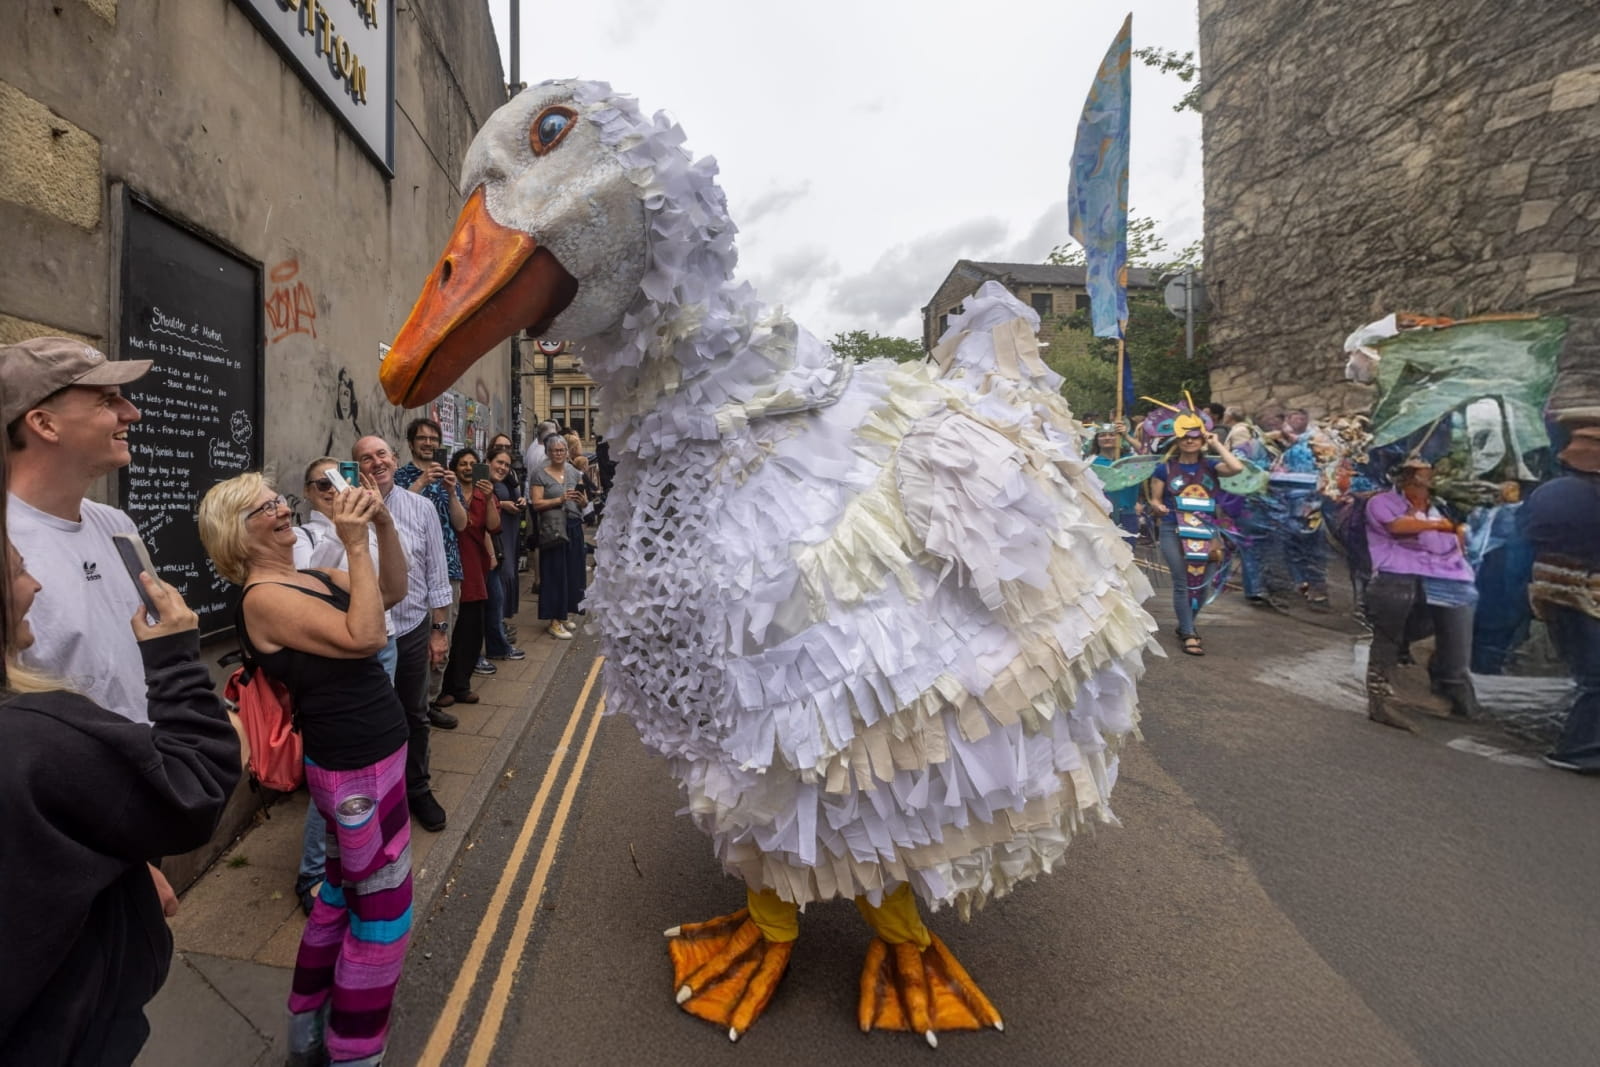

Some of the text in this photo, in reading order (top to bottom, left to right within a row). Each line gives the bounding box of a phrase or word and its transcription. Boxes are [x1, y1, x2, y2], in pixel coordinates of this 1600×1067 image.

[286, 0, 366, 105] TTON
[191, 323, 199, 336] of
[168, 366, 180, 377] Kids
